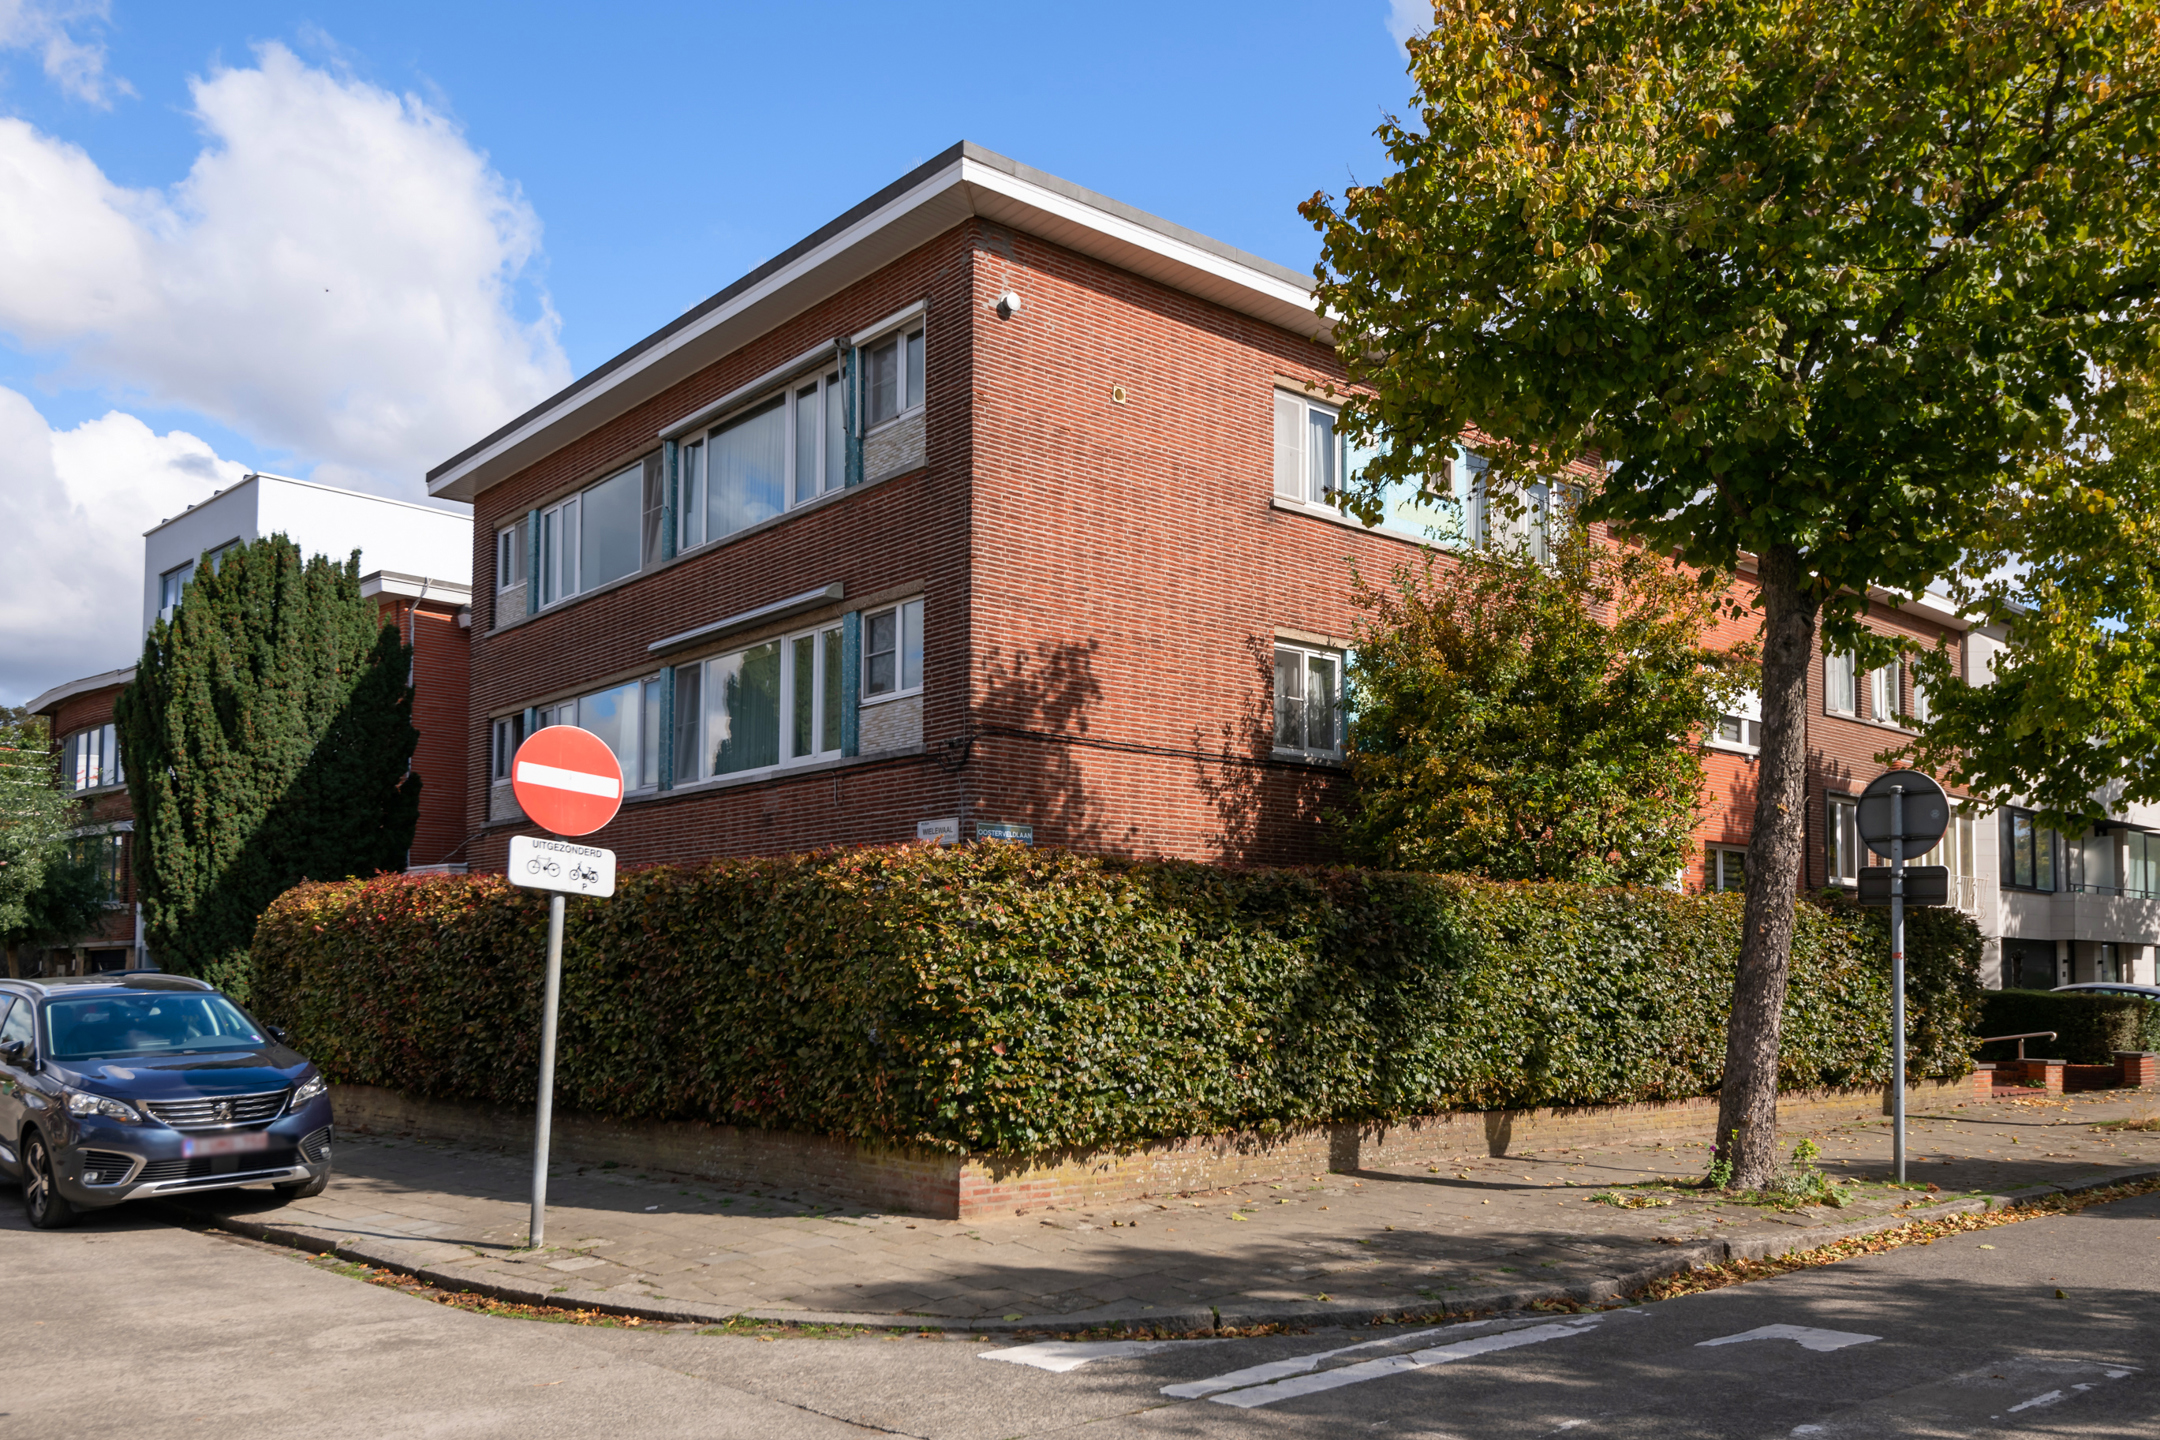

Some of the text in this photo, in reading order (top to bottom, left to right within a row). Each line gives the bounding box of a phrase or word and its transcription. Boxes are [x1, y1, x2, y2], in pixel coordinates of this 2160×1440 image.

[922, 825, 954, 836] WIELEWAAL
[978, 828, 1032, 839] OOSTERVELDLAAN
[532, 839, 603, 858] UITGEZONDERD
[582, 883, 588, 891] P
